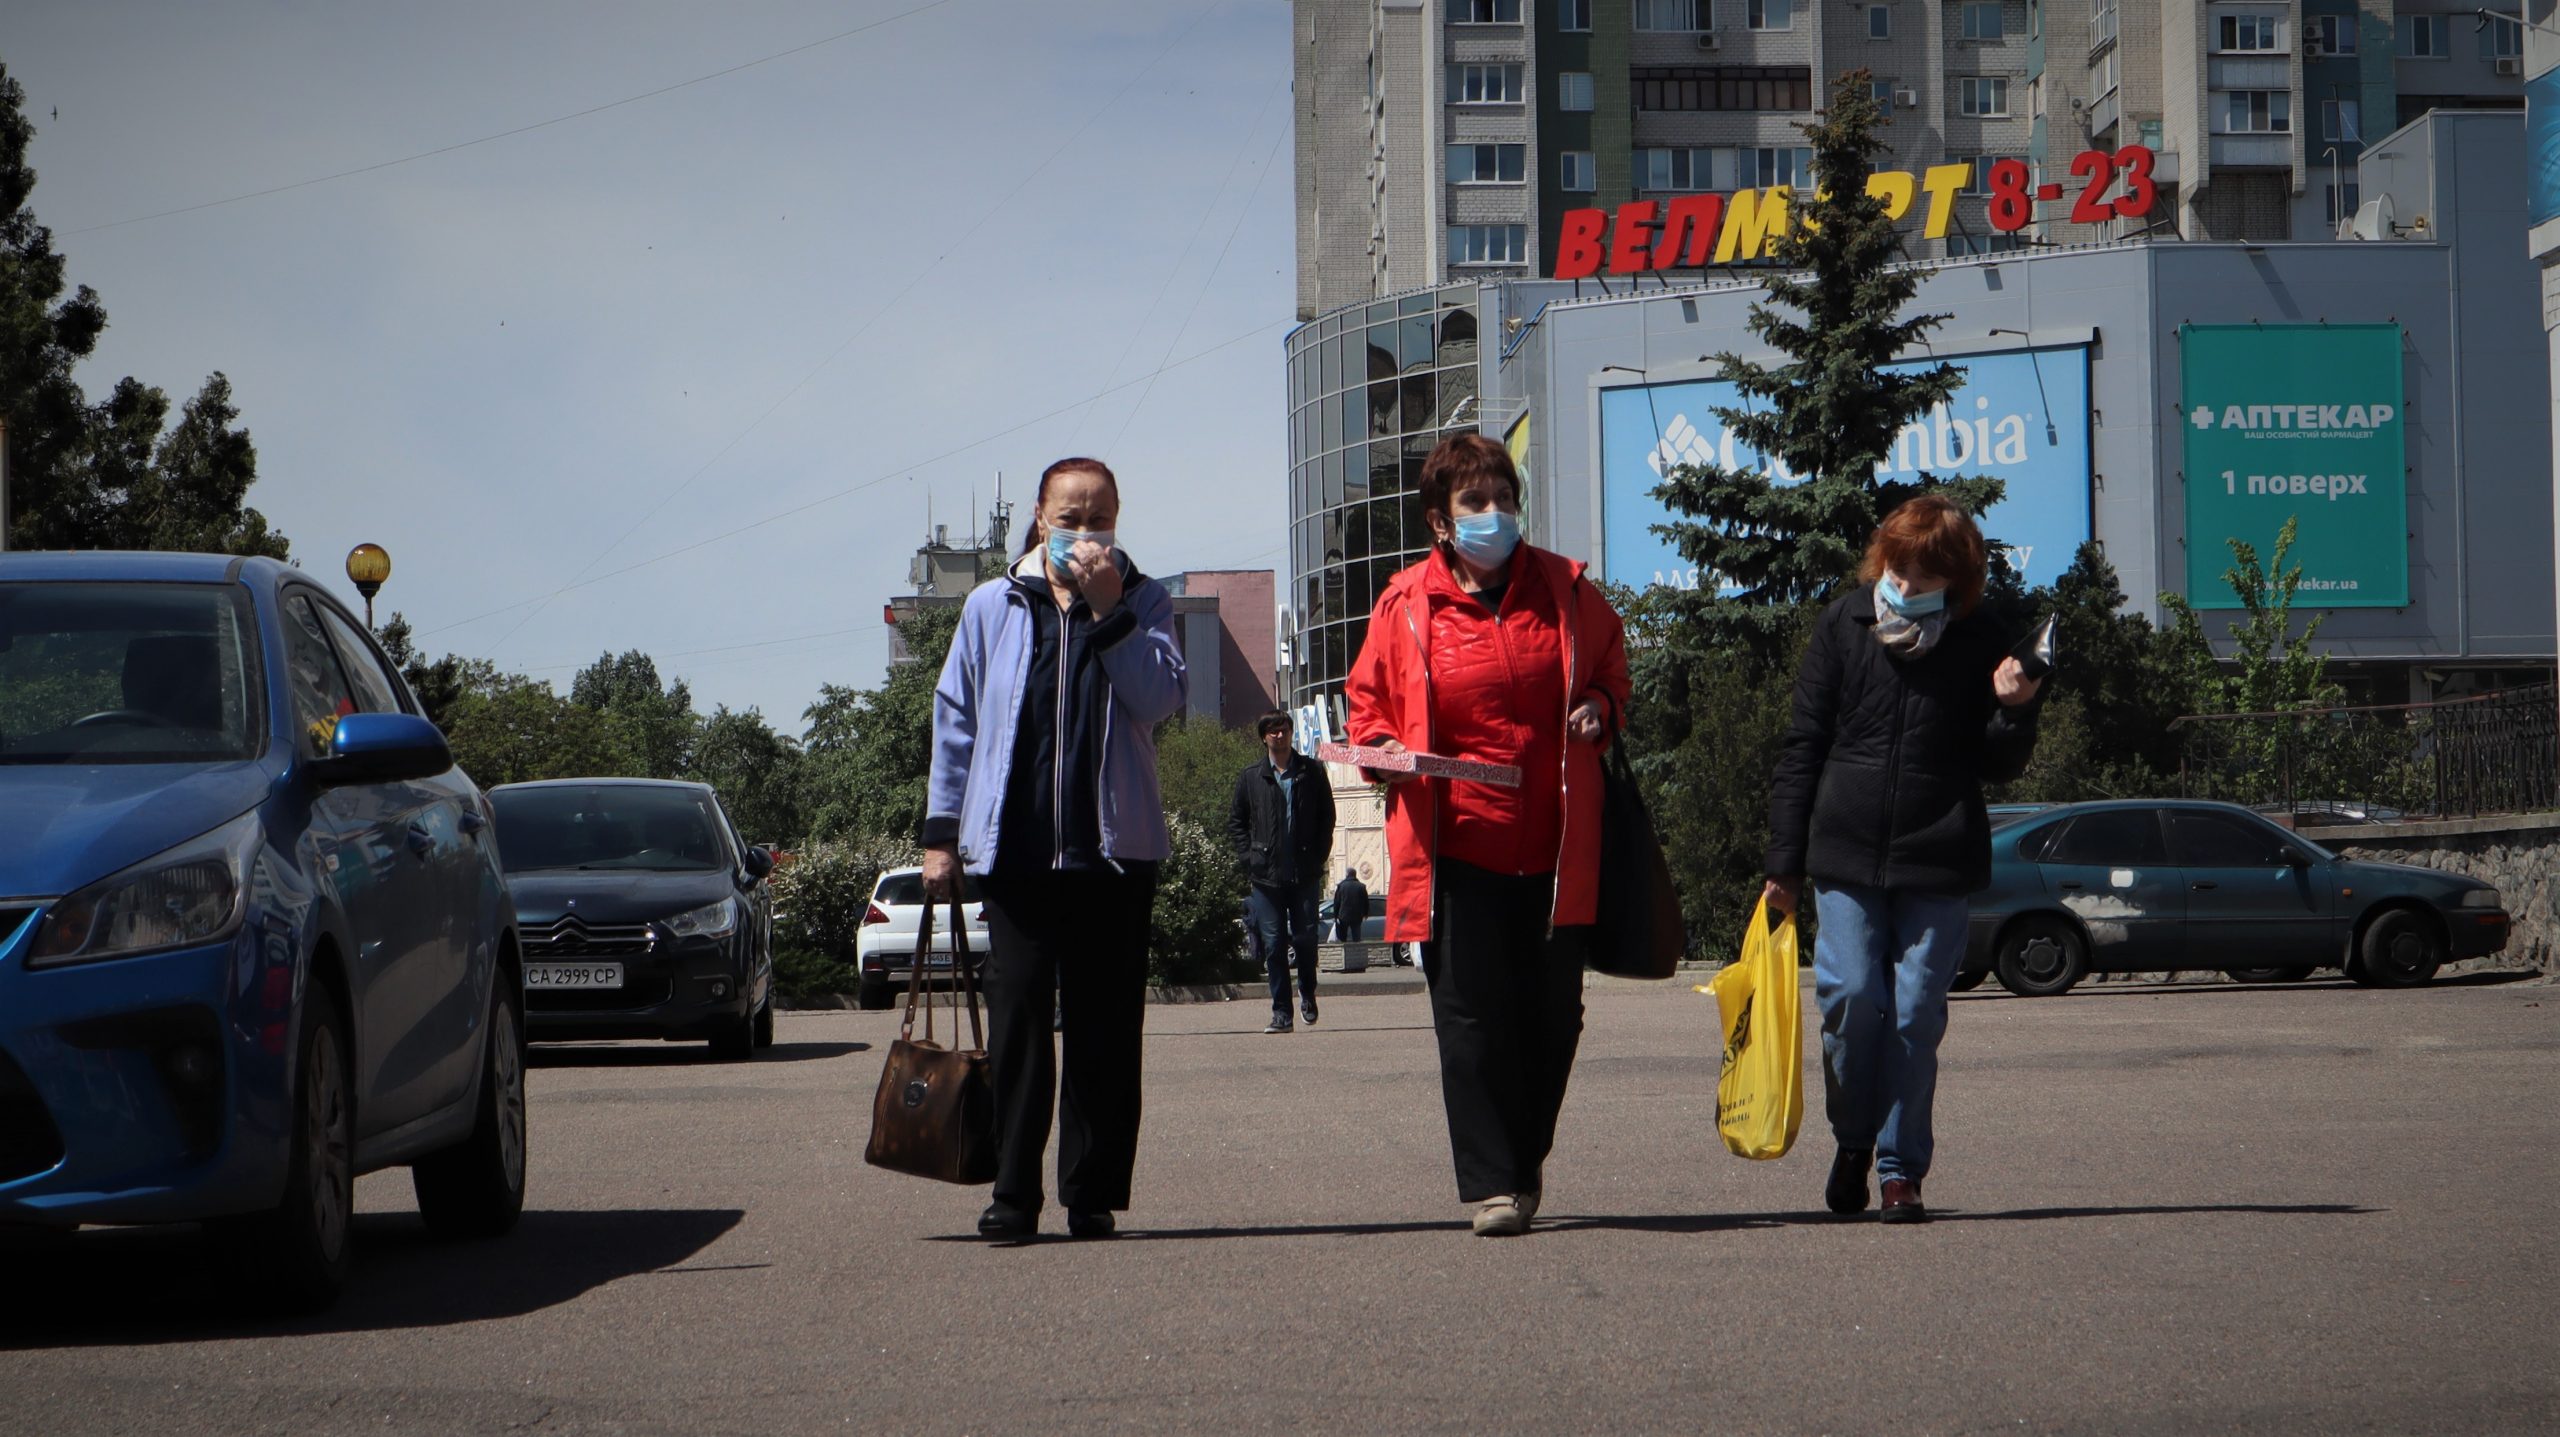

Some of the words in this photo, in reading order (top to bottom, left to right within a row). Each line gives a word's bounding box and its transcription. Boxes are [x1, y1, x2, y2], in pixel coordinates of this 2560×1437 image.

[1554, 163, 1974, 280] ВЕЛМРТ
[2221, 404, 2395, 430] АПТЕКАР
[2244, 431, 2265, 440] ВАШ
[2266, 430, 2320, 440] ОСОБИСТИЙ
[2321, 431, 2374, 440] ФАРМАЦЕВТ
[2221, 470, 2235, 495] 1
[2247, 474, 2368, 501] поверх
[528, 968, 550, 984] CA
[554, 968, 590, 985] 2999
[593, 967, 616, 984] CP
